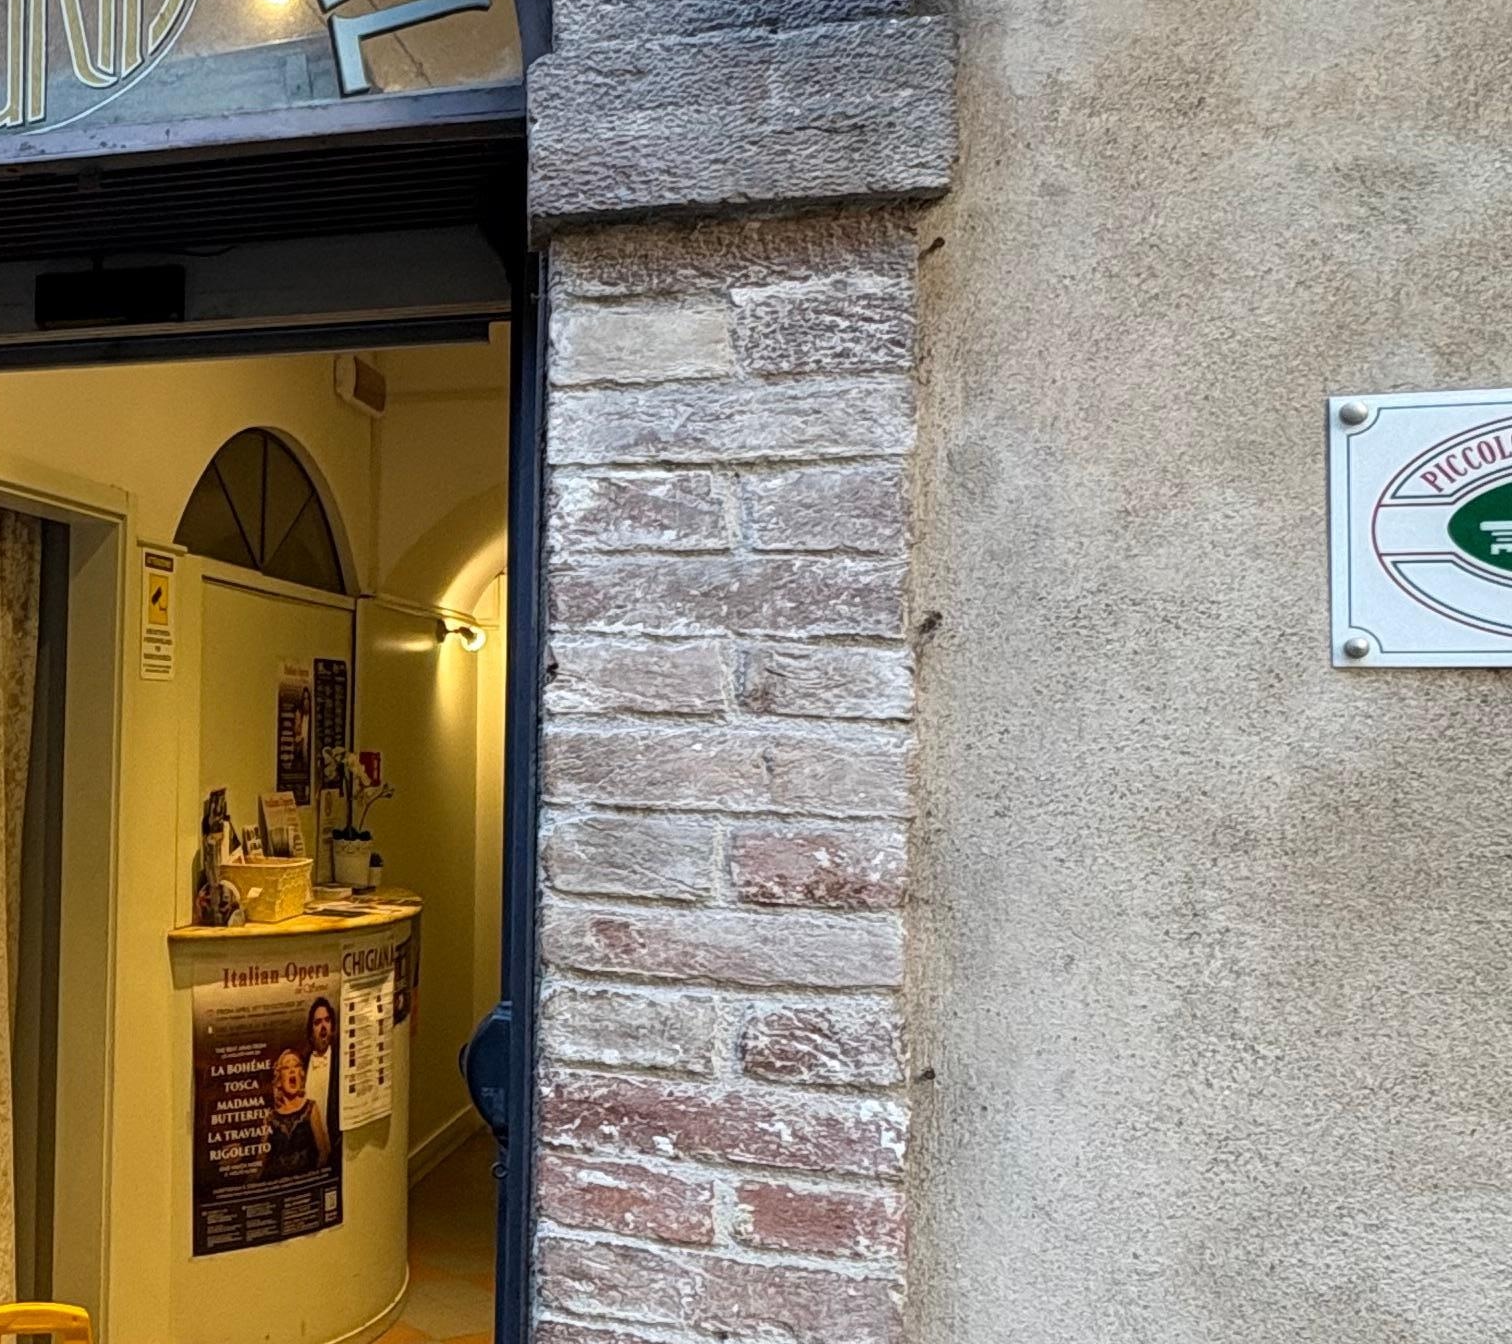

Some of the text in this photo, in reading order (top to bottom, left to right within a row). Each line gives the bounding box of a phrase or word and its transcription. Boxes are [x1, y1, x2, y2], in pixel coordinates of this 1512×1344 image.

[1420, 435, 1512, 493] PICCOL
[223, 962, 329, 989] Italian Opera
[210, 1065, 225, 1077] LA
[224, 1079, 259, 1093] TOSCA
[217, 1096, 265, 1111] MADAMA
[211, 1107, 272, 1126] BUTTERFLY
[208, 1125, 273, 1144] LA TRAVIATA
[209, 1142, 272, 1161] RIGOLETTO
